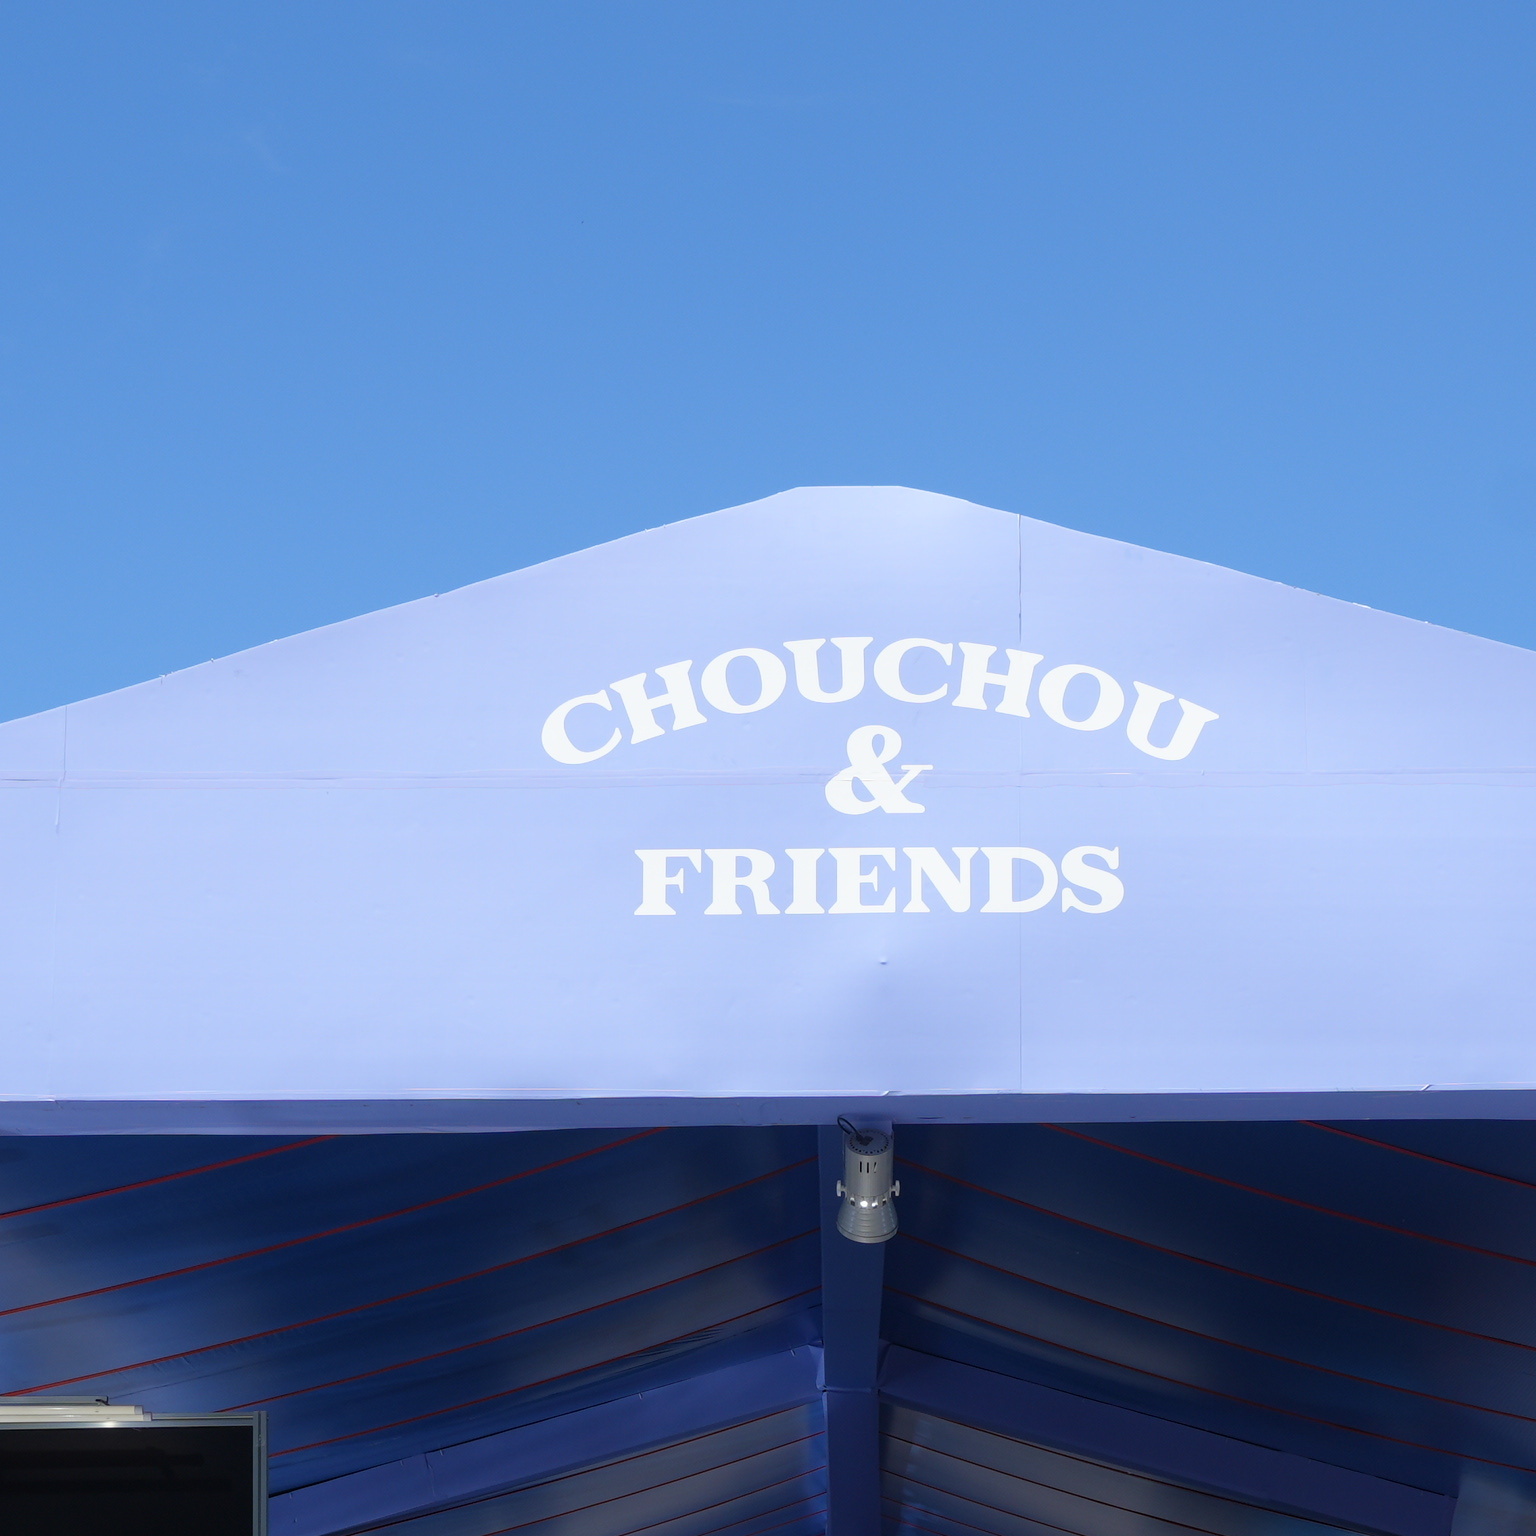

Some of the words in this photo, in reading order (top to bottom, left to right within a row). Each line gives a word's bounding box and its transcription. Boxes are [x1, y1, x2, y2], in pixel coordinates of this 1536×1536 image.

[541, 636, 1219, 765] CHOUCHOU
[824, 724, 933, 815] &
[634, 845, 1125, 916] FRIENDS
